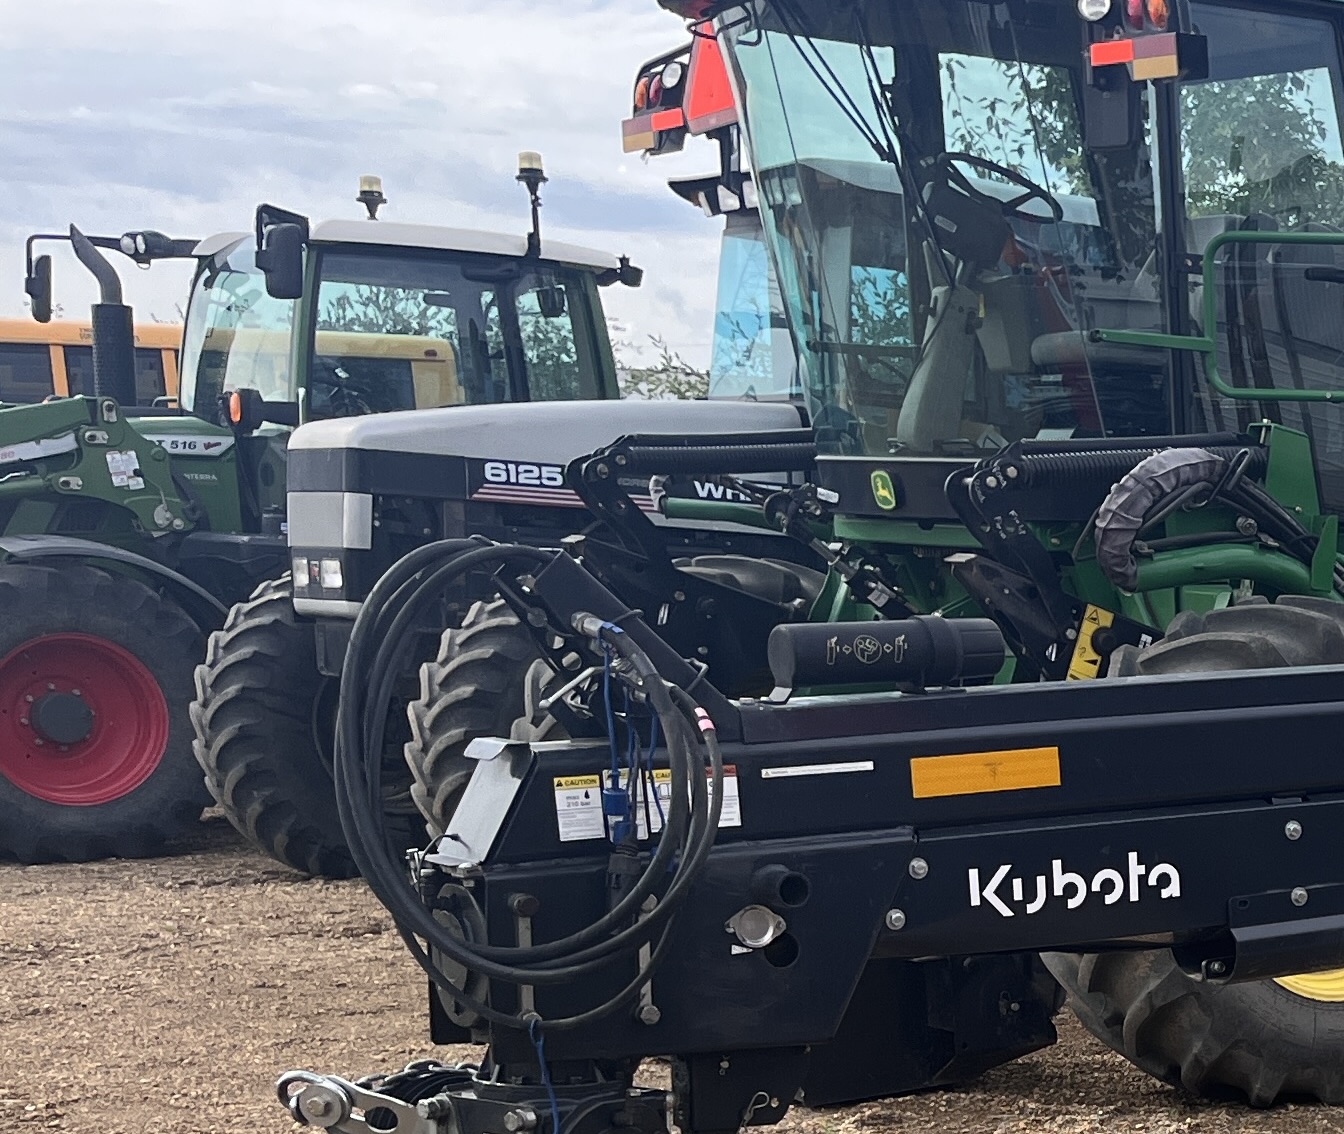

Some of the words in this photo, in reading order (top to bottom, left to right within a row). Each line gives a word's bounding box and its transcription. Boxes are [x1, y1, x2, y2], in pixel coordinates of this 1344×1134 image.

[170, 440, 197, 450] 516
[484, 461, 564, 487] 6125
[564, 778, 598, 787] CAUTION
[968, 851, 1182, 917] Kubota
